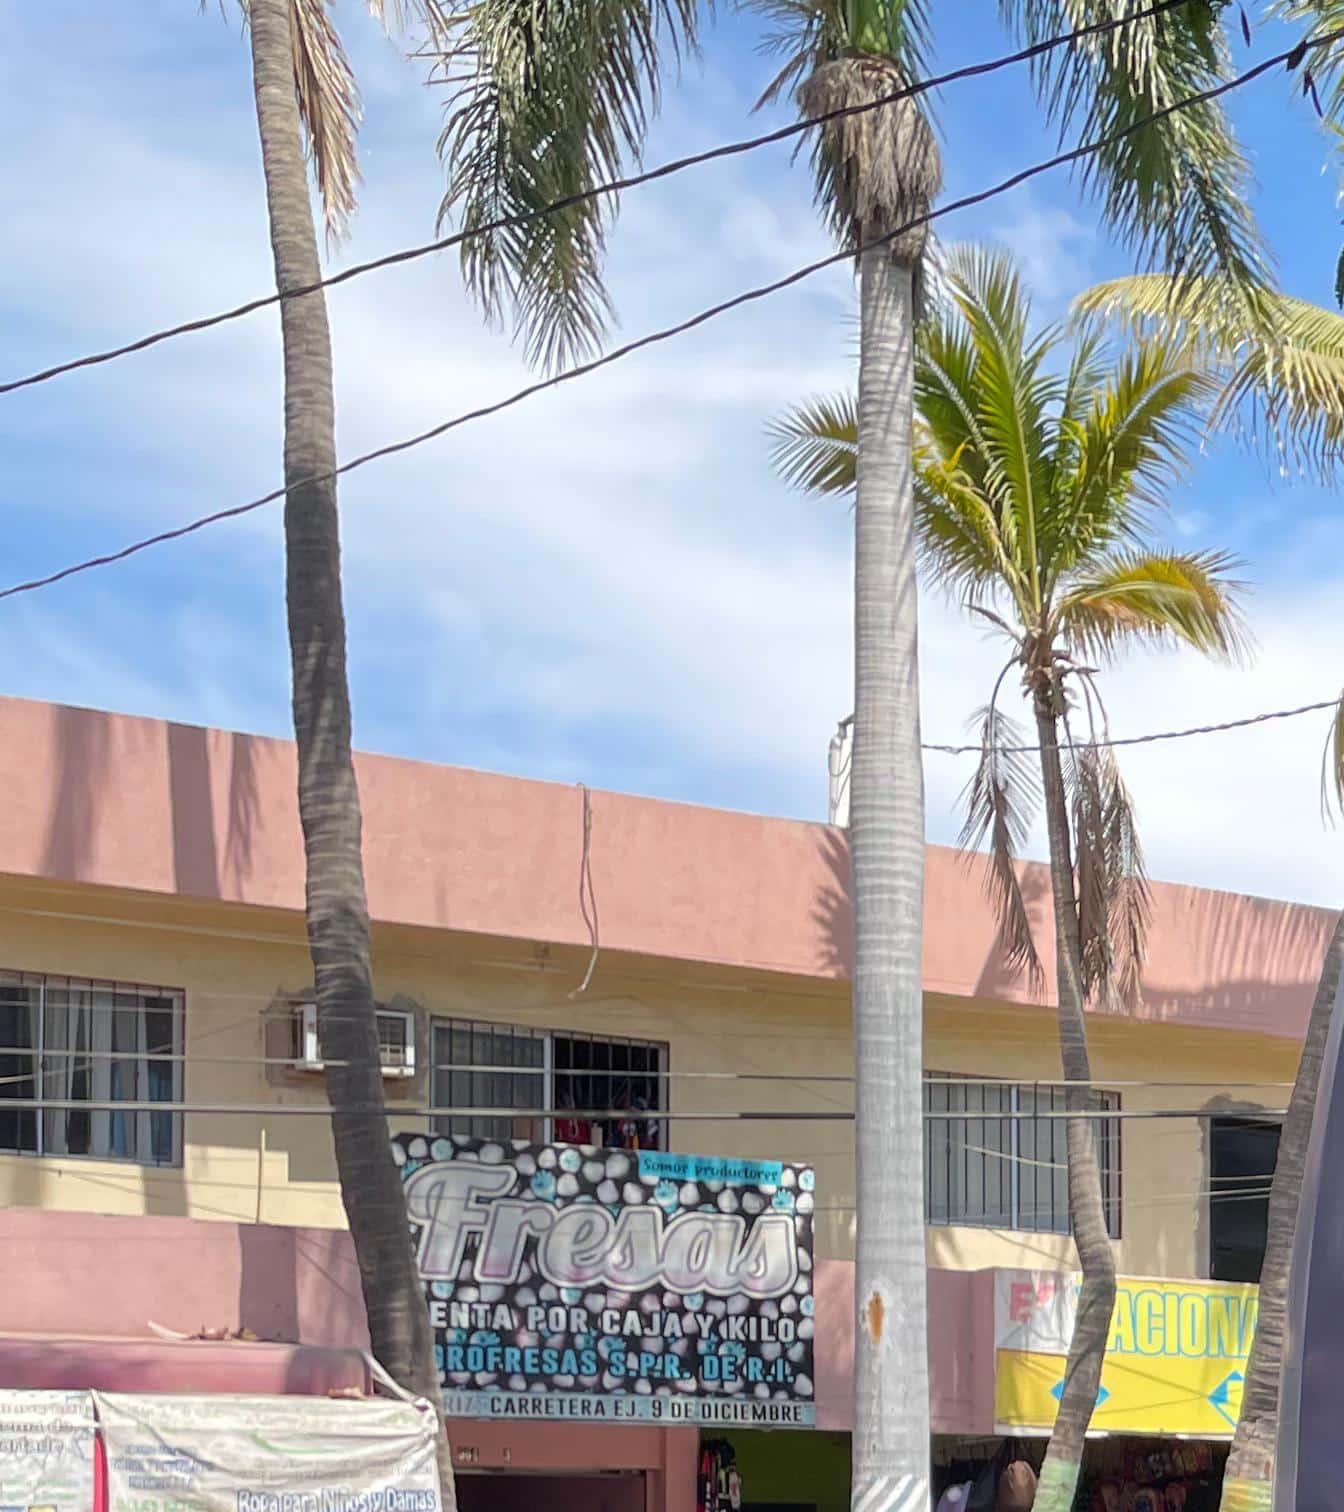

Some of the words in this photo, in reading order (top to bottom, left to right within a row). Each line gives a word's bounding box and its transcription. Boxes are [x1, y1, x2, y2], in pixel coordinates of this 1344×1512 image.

[404, 1161, 798, 1298] Fresas
[429, 1301, 513, 1330] ENTA
[527, 1306, 588, 1334] POR
[602, 1309, 683, 1338] CAJA
[695, 1314, 714, 1339] Y
[728, 1316, 794, 1343] KILO
[610, 1352, 692, 1379] S.P.R.
[703, 1355, 736, 1380] DE
[748, 1358, 795, 1383] R.I.
[490, 1396, 605, 1416] CARRETERA
[652, 1400, 662, 1418] 9
[671, 1401, 693, 1418] DE
[701, 1402, 802, 1421] DICIEMBRE
